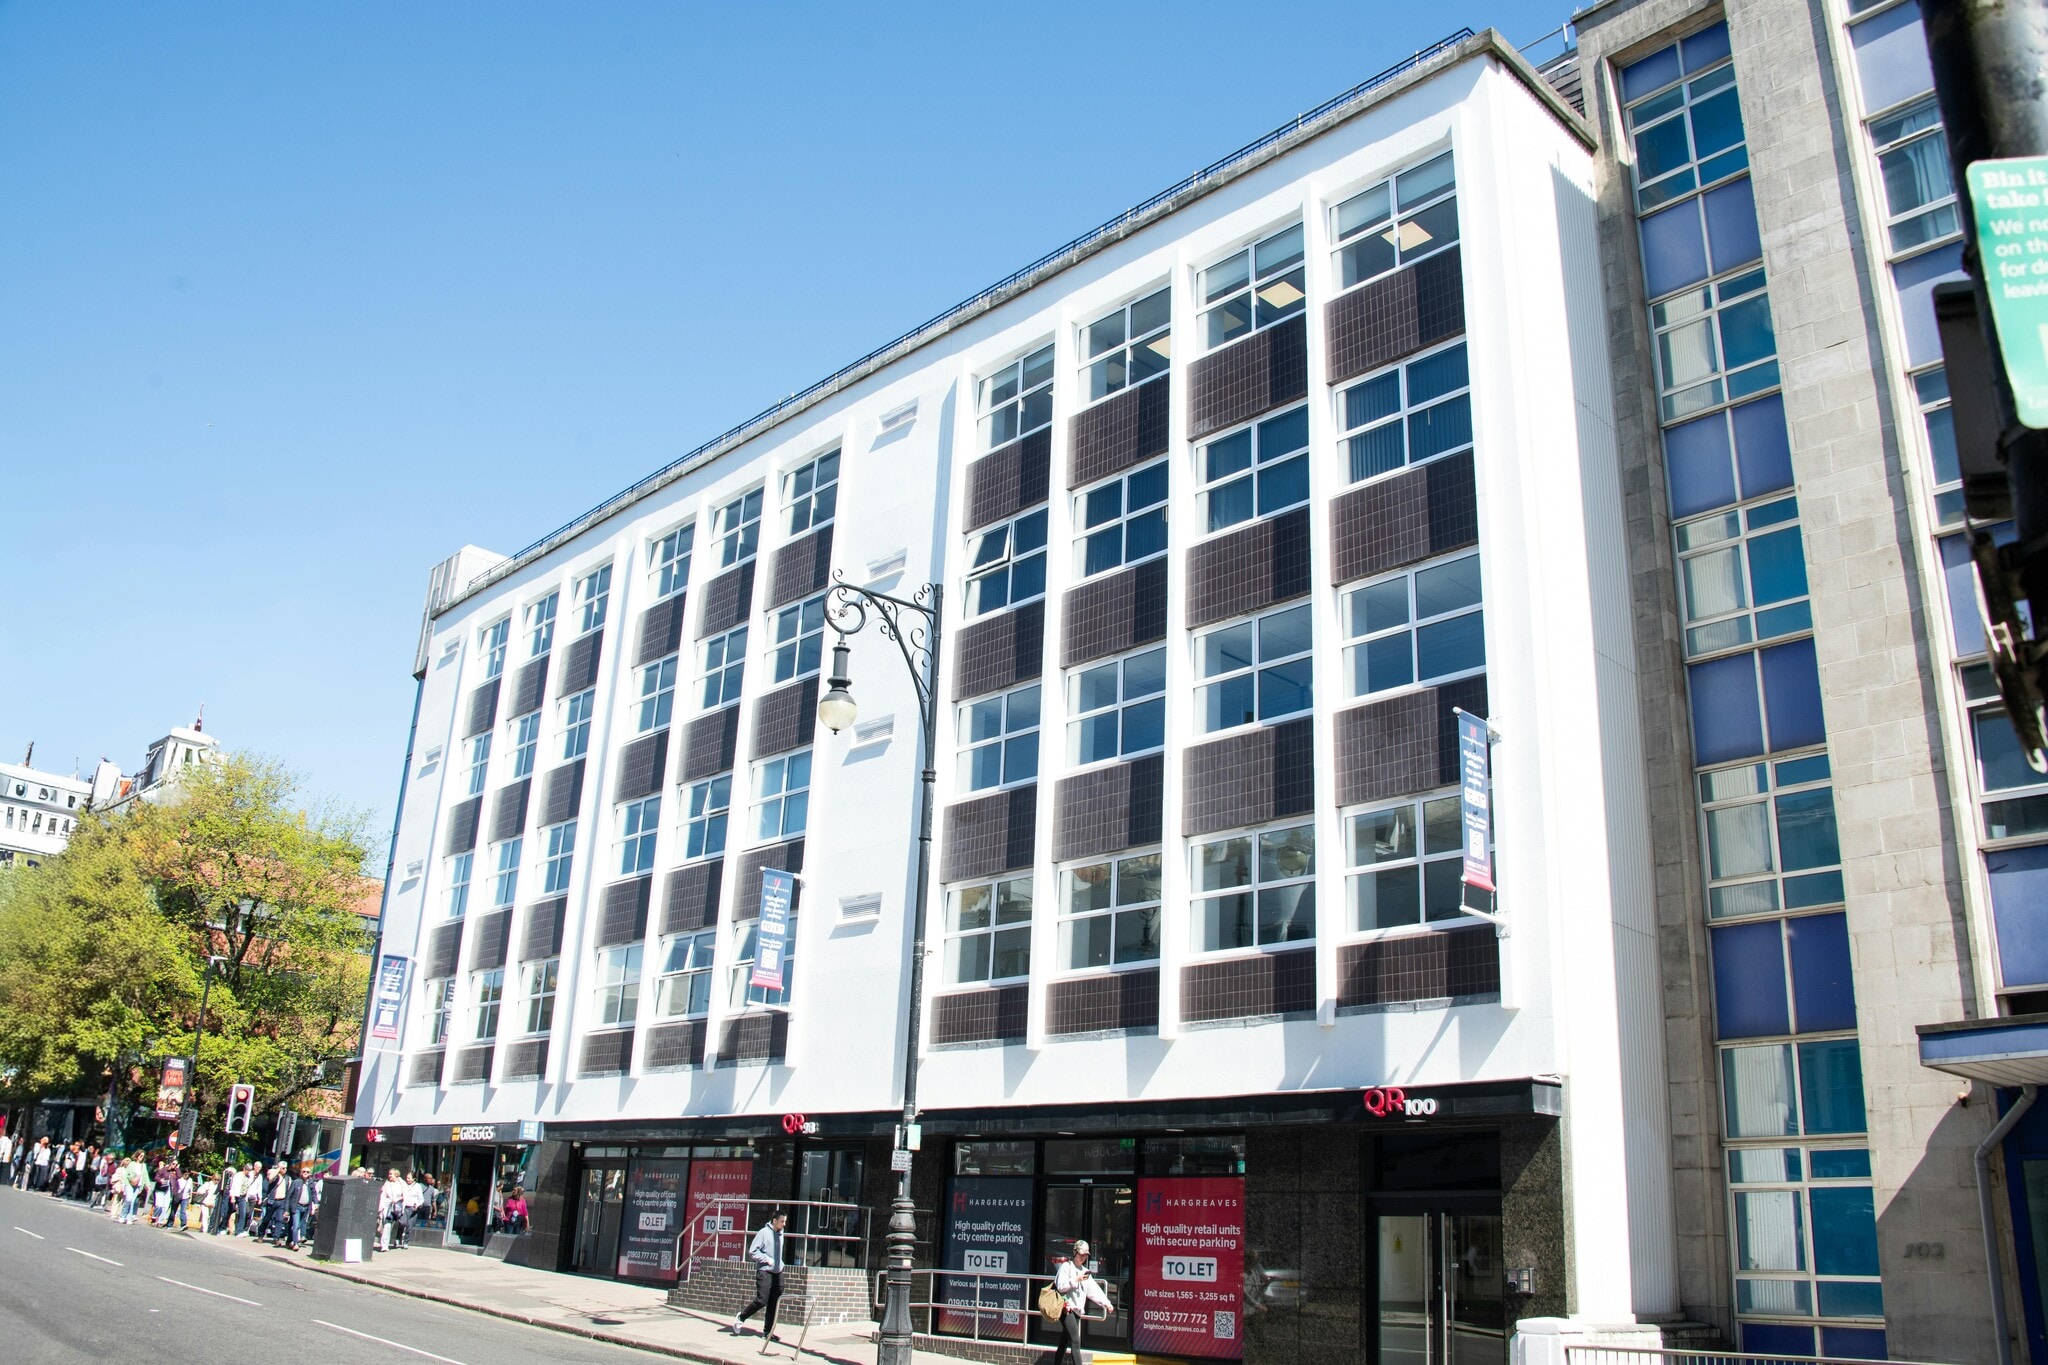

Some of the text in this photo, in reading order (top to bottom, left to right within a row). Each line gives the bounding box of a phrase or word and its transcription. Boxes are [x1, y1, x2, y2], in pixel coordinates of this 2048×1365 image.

[1981, 168, 2026, 188] Bin
[1986, 190, 2040, 210] take
[1989, 218, 2024, 236] We
[1995, 242, 2022, 257] on
[1999, 261, 2027, 278] for
[460, 1126, 494, 1140] GREGGS
[635, 1190, 644, 1198] High
[645, 1190, 660, 1199] quality
[694, 1192, 705, 1200] High
[660, 1200, 677, 1208] parking
[652, 1217, 664, 1227] LET
[706, 1220, 716, 1229] TO
[955, 1220, 1022, 1232] High quality offices
[1142, 1223, 1241, 1236] High quality retail units
[957, 1232, 971, 1242] city
[972, 1233, 994, 1241] centre
[995, 1233, 1024, 1244] parking
[1145, 1235, 1236, 1250] with secure parking
[968, 1255, 1004, 1268] TO LET
[1167, 1262, 1214, 1276] TO LET
[1176, 1291, 1193, 1300] 1,565
[1199, 1292, 1218, 1301] 3,255
[1144, 1311, 1207, 1324] 01903 777 772
[1144, 1323, 1206, 1333] brighton.hargreaves.co.uk
